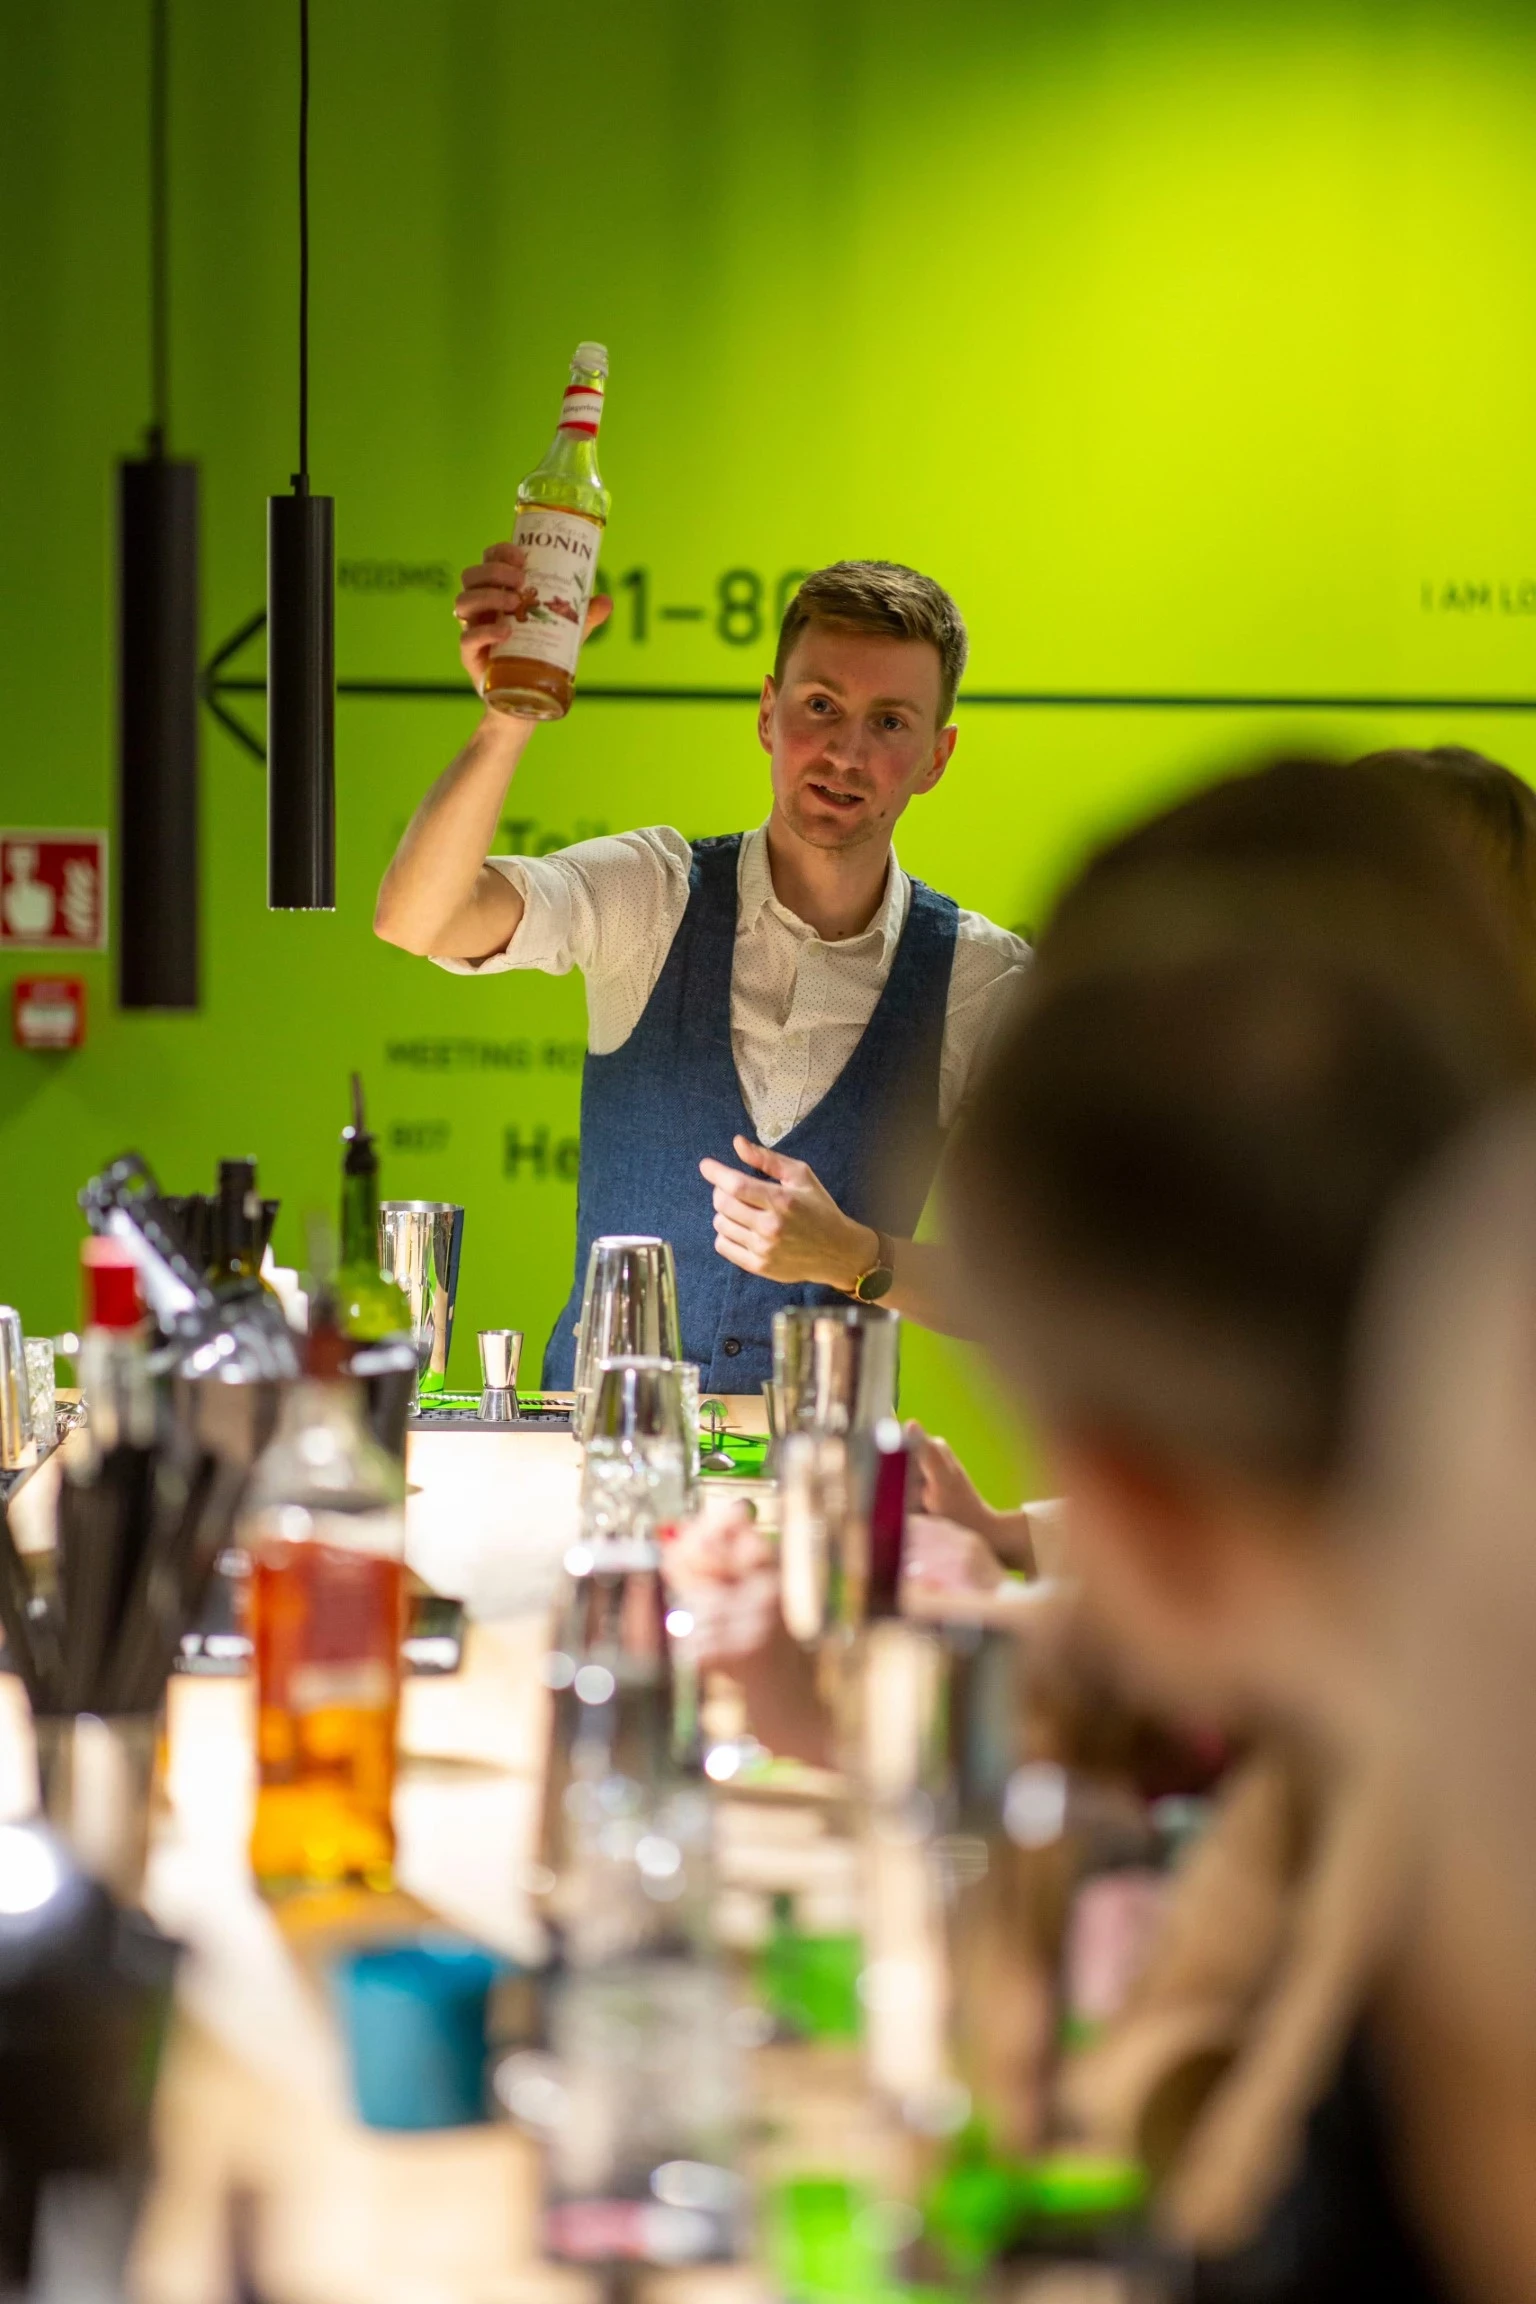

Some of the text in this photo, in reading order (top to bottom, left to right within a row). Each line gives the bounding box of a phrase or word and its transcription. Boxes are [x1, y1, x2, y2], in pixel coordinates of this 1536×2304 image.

[518, 531, 593, 561] MONIN
[1440, 580, 1491, 613] AM
[385, 1038, 531, 1071] MEETING
